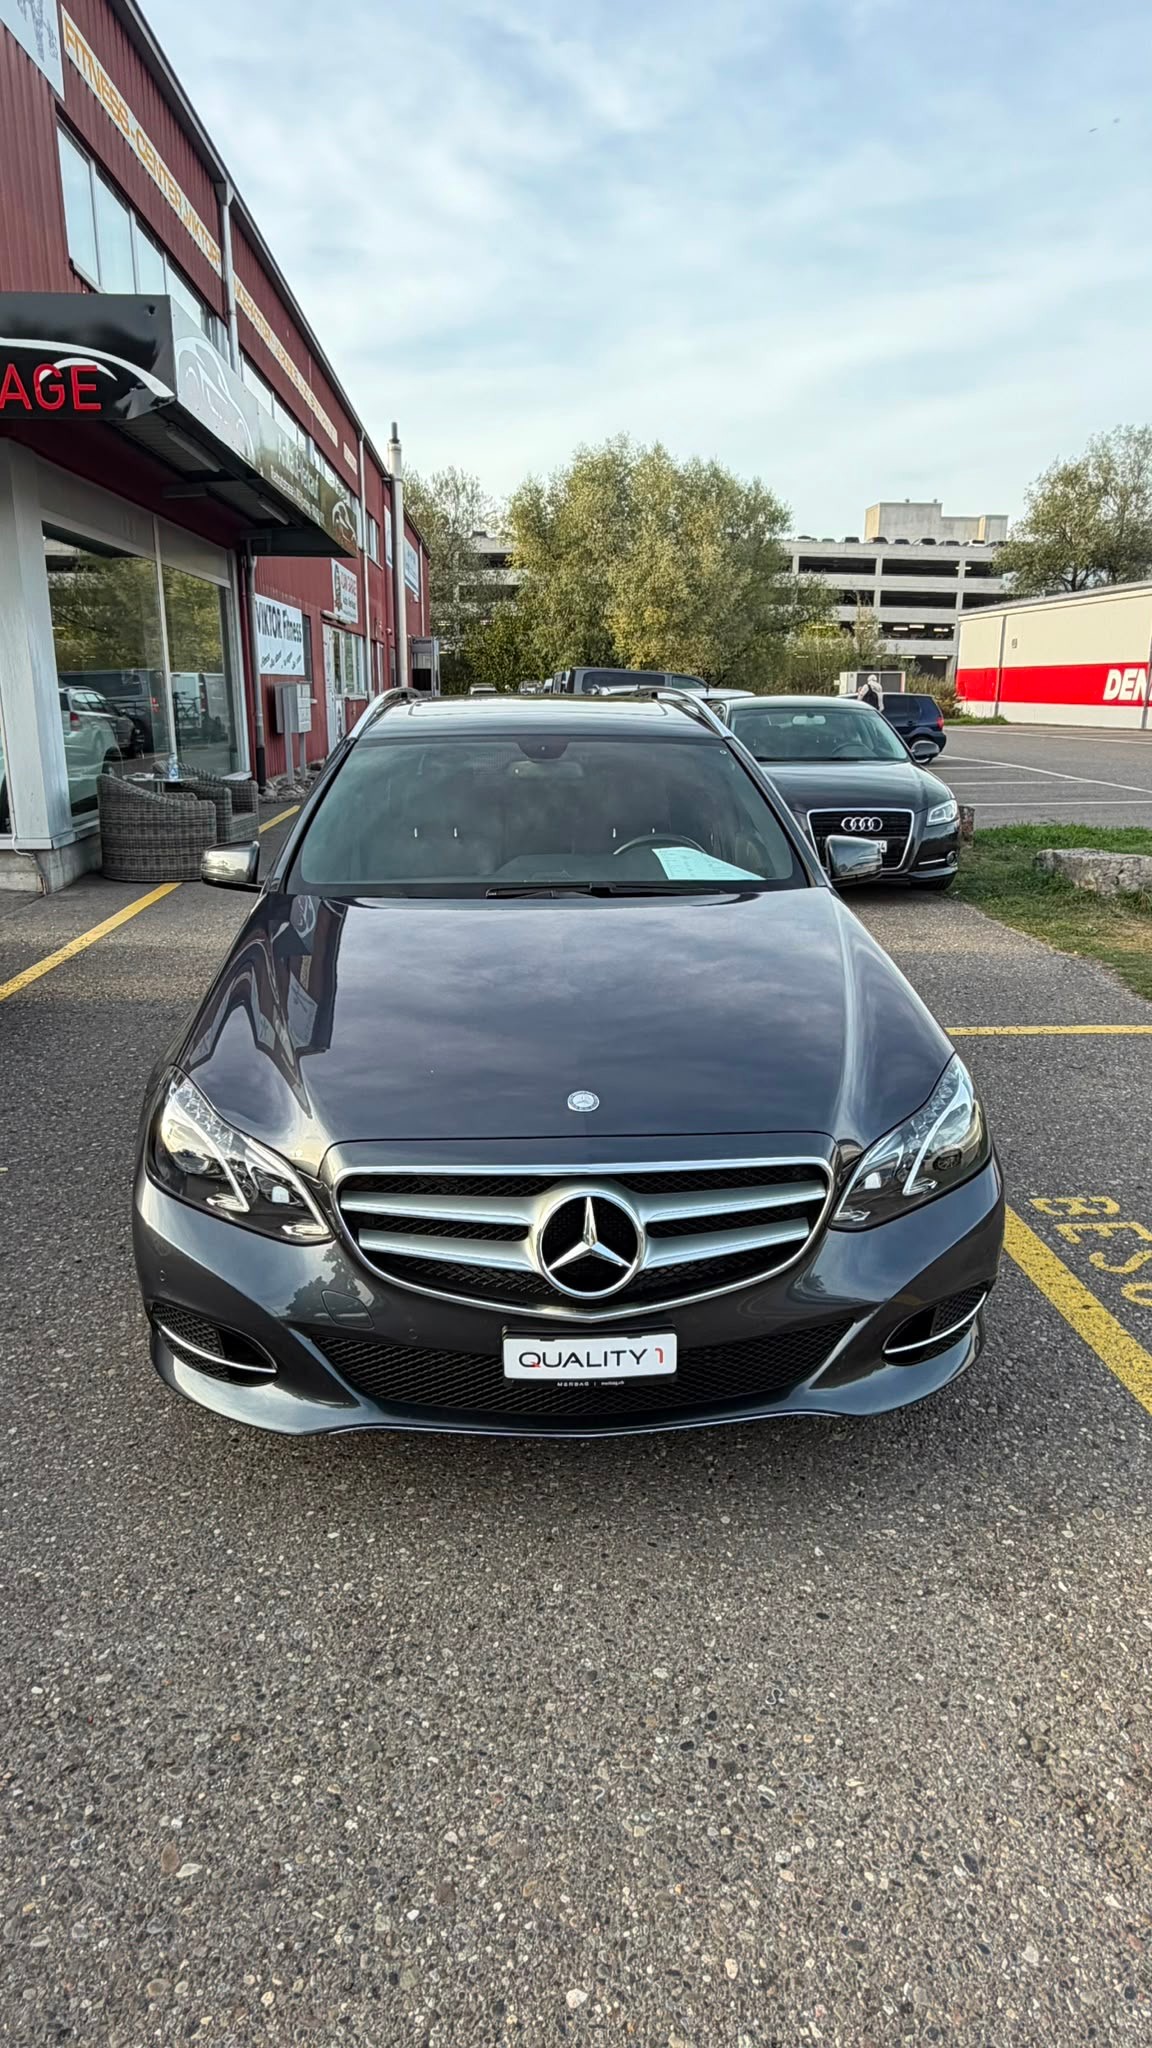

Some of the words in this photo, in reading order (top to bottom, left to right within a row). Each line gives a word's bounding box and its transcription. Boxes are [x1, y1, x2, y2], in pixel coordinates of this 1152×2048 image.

[0, 363, 102, 410] AGE
[255, 600, 283, 640] VIKTOR
[283, 608, 302, 643] Fitness
[1102, 668, 1152, 701] DEN
[518, 1348, 648, 1368] QUALITY
[655, 1347, 664, 1364] 1
